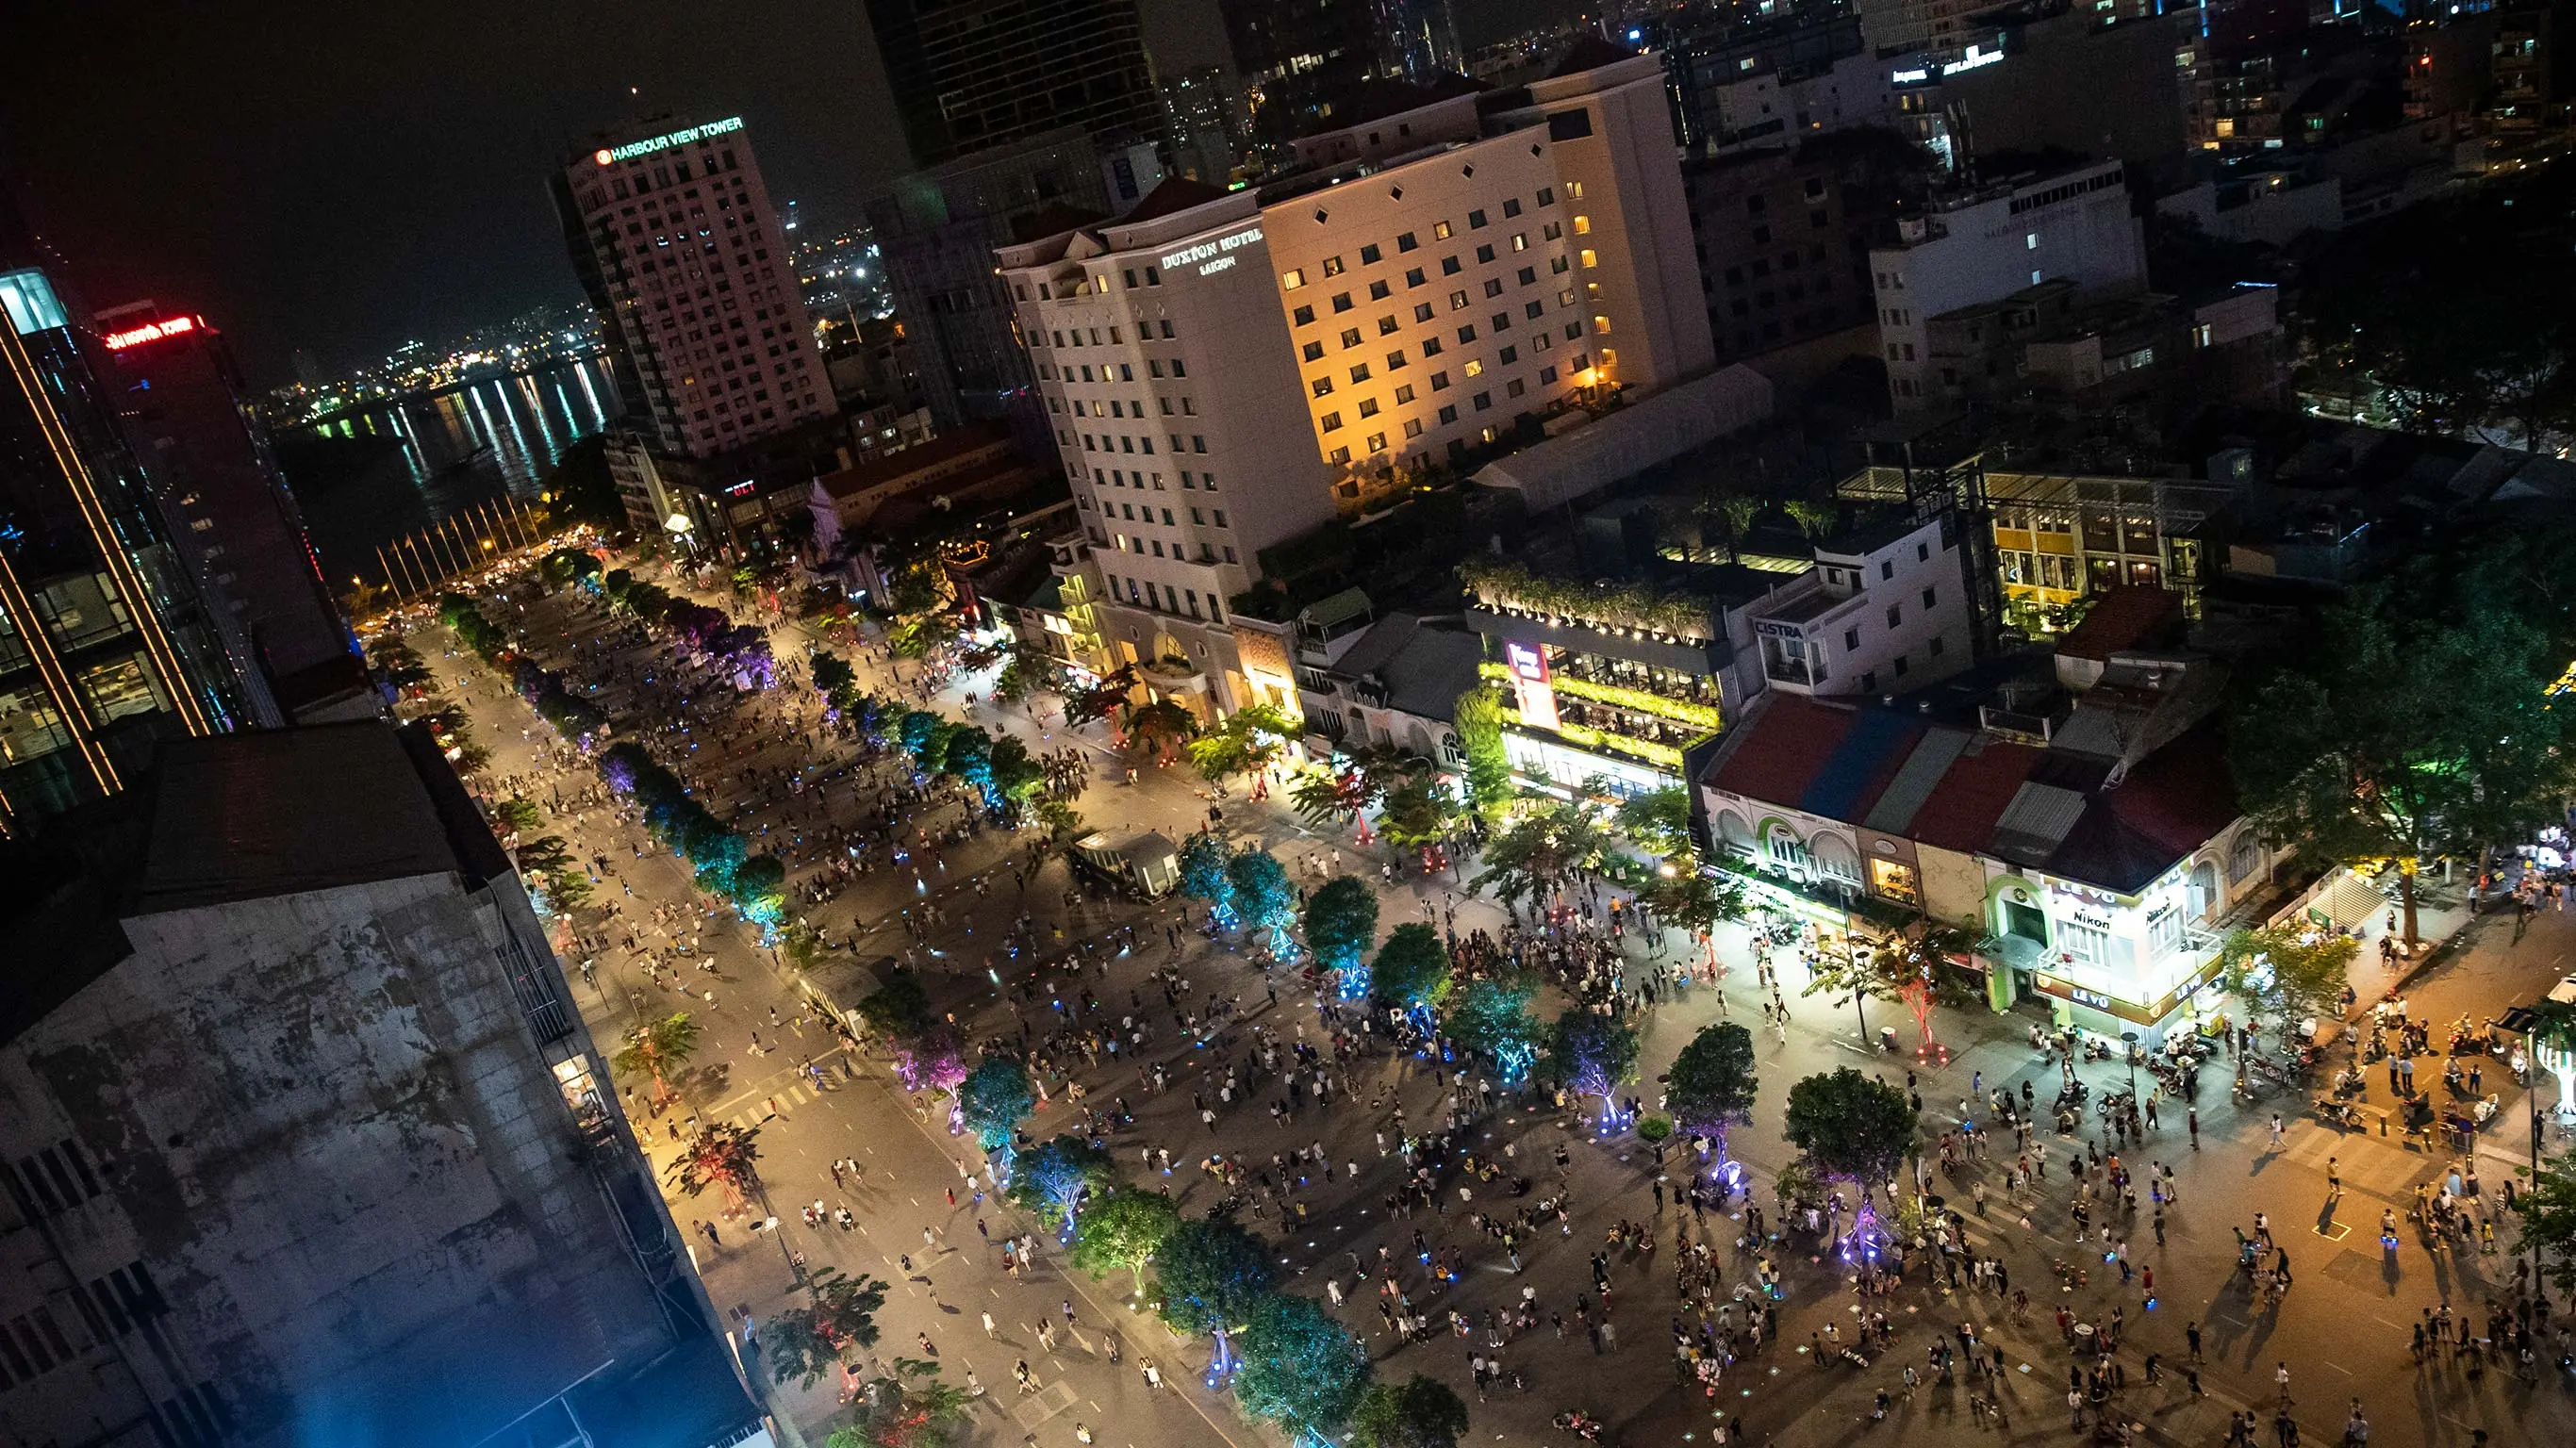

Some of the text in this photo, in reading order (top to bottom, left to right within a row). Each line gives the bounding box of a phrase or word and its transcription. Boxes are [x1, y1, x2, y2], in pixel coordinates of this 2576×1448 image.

[611, 116, 743, 160] HARBOUR VIEW TOWER
[1162, 228, 1263, 270] DUXTON HOTEL
[1198, 255, 1236, 276] SAIGON
[2073, 912, 2110, 930] Nikon
